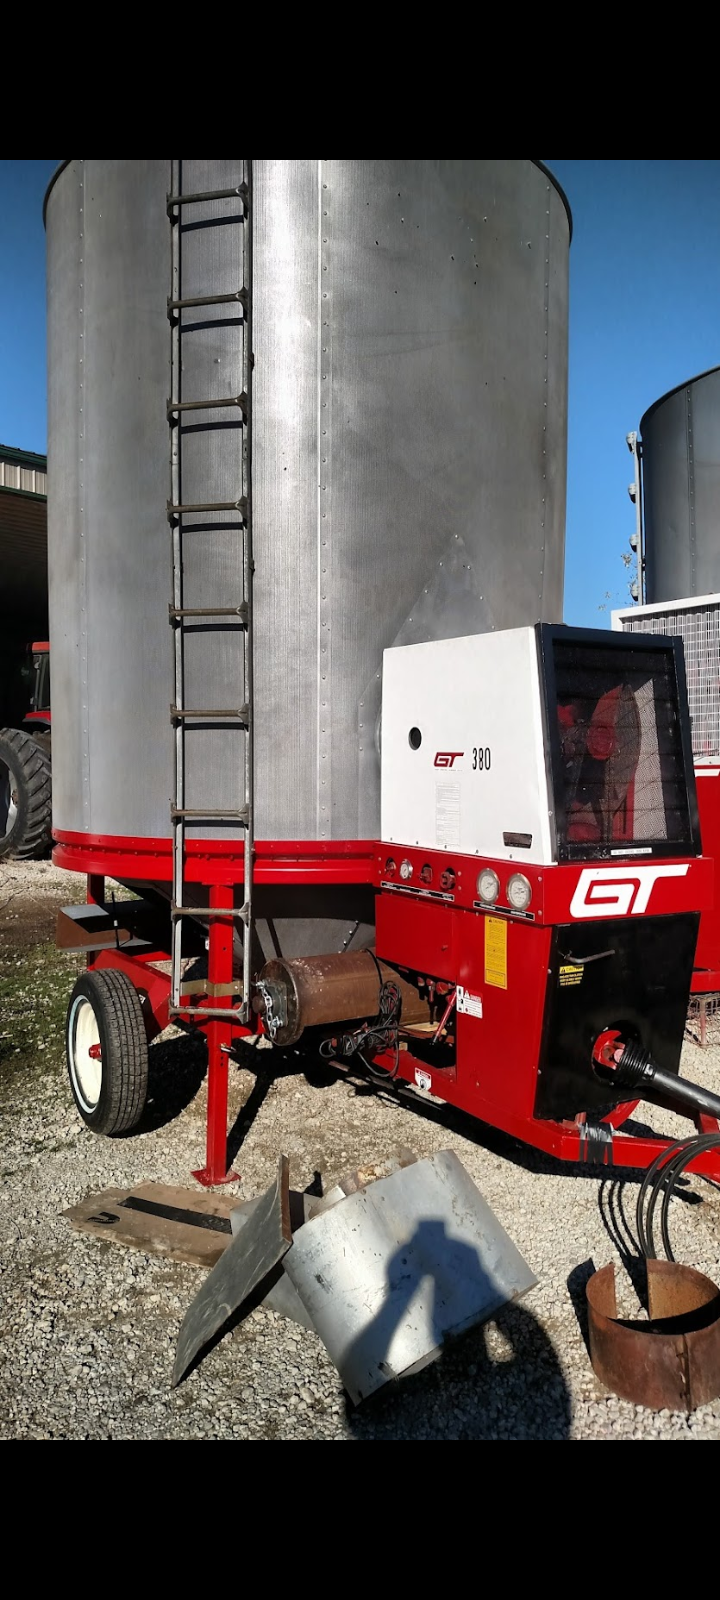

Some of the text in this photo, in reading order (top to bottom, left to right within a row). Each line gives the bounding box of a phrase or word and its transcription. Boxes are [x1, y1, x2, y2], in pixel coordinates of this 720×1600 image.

[434, 747, 491, 770] GT 380
[569, 864, 690, 919] GT
